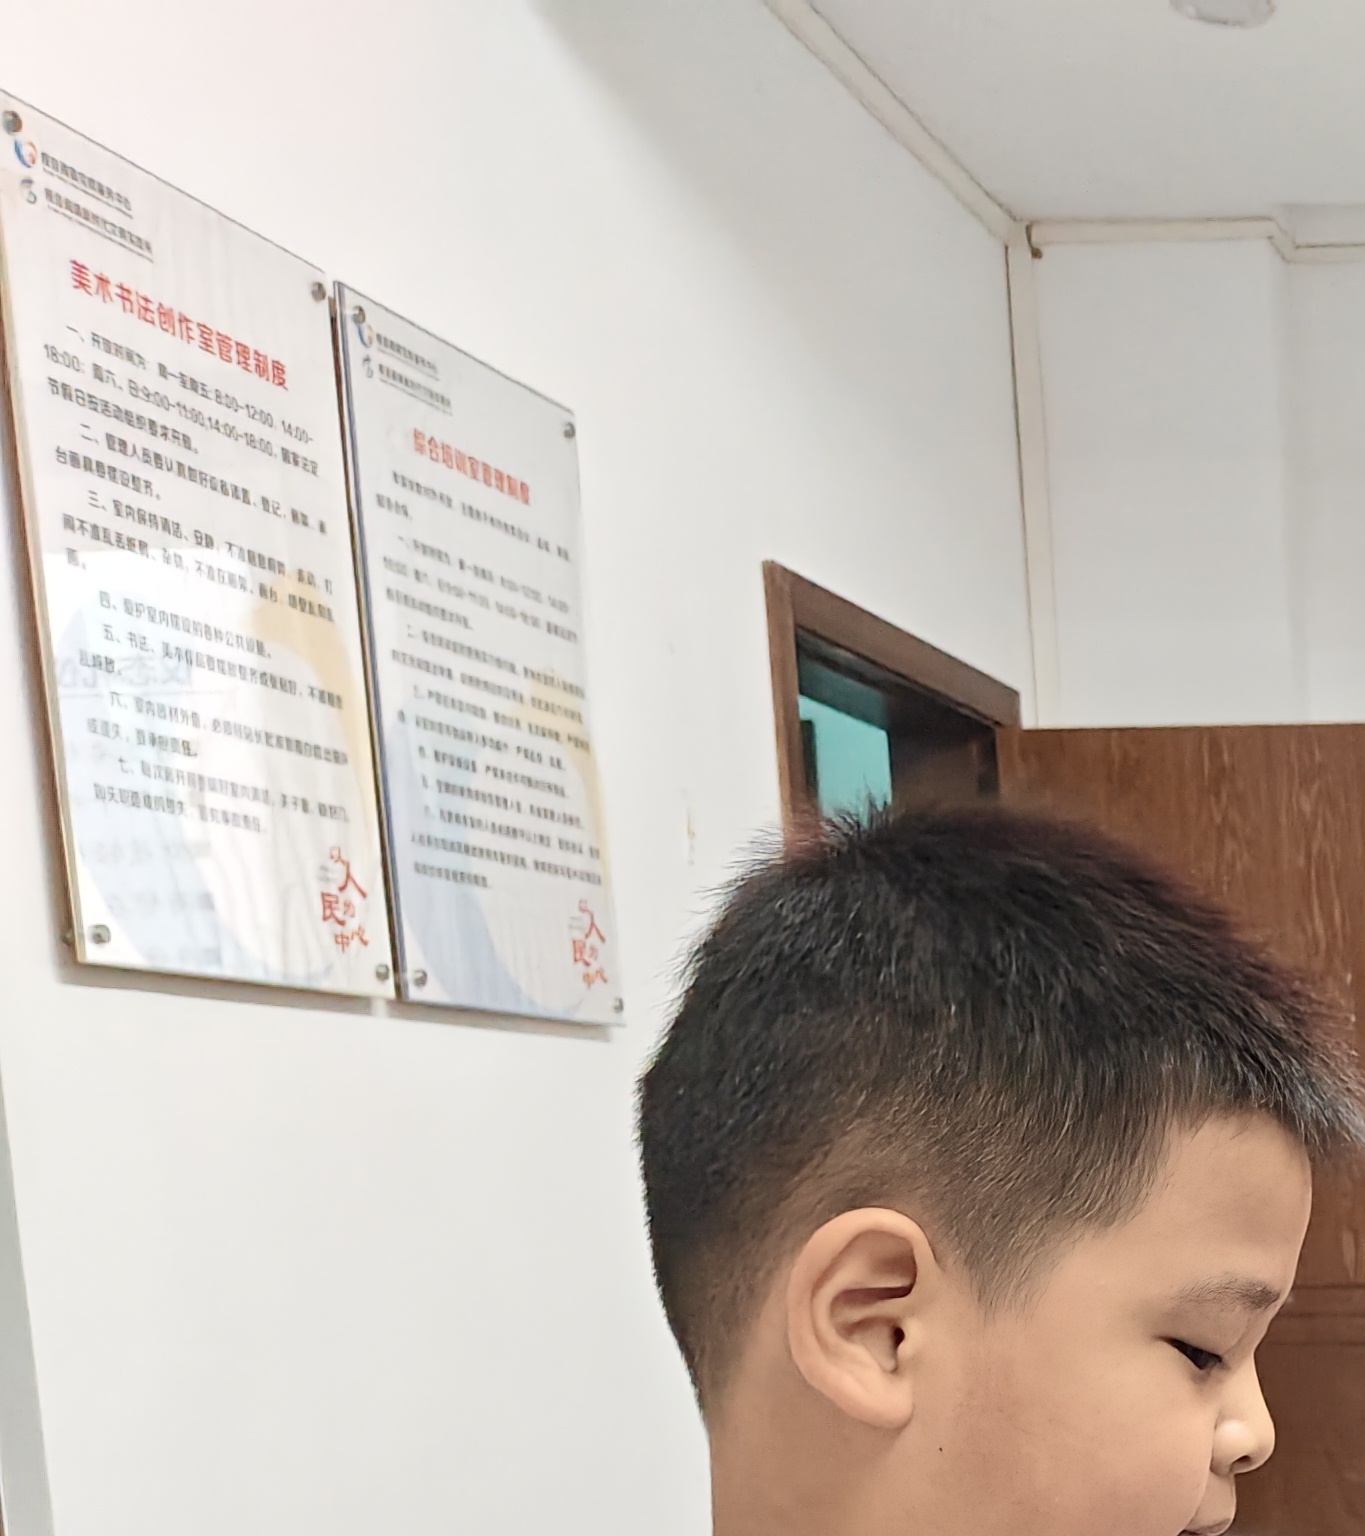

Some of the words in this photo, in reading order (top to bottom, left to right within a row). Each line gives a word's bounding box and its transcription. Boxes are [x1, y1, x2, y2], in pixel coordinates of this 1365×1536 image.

[68, 256, 289, 392] 美术书法创作室管理制度
